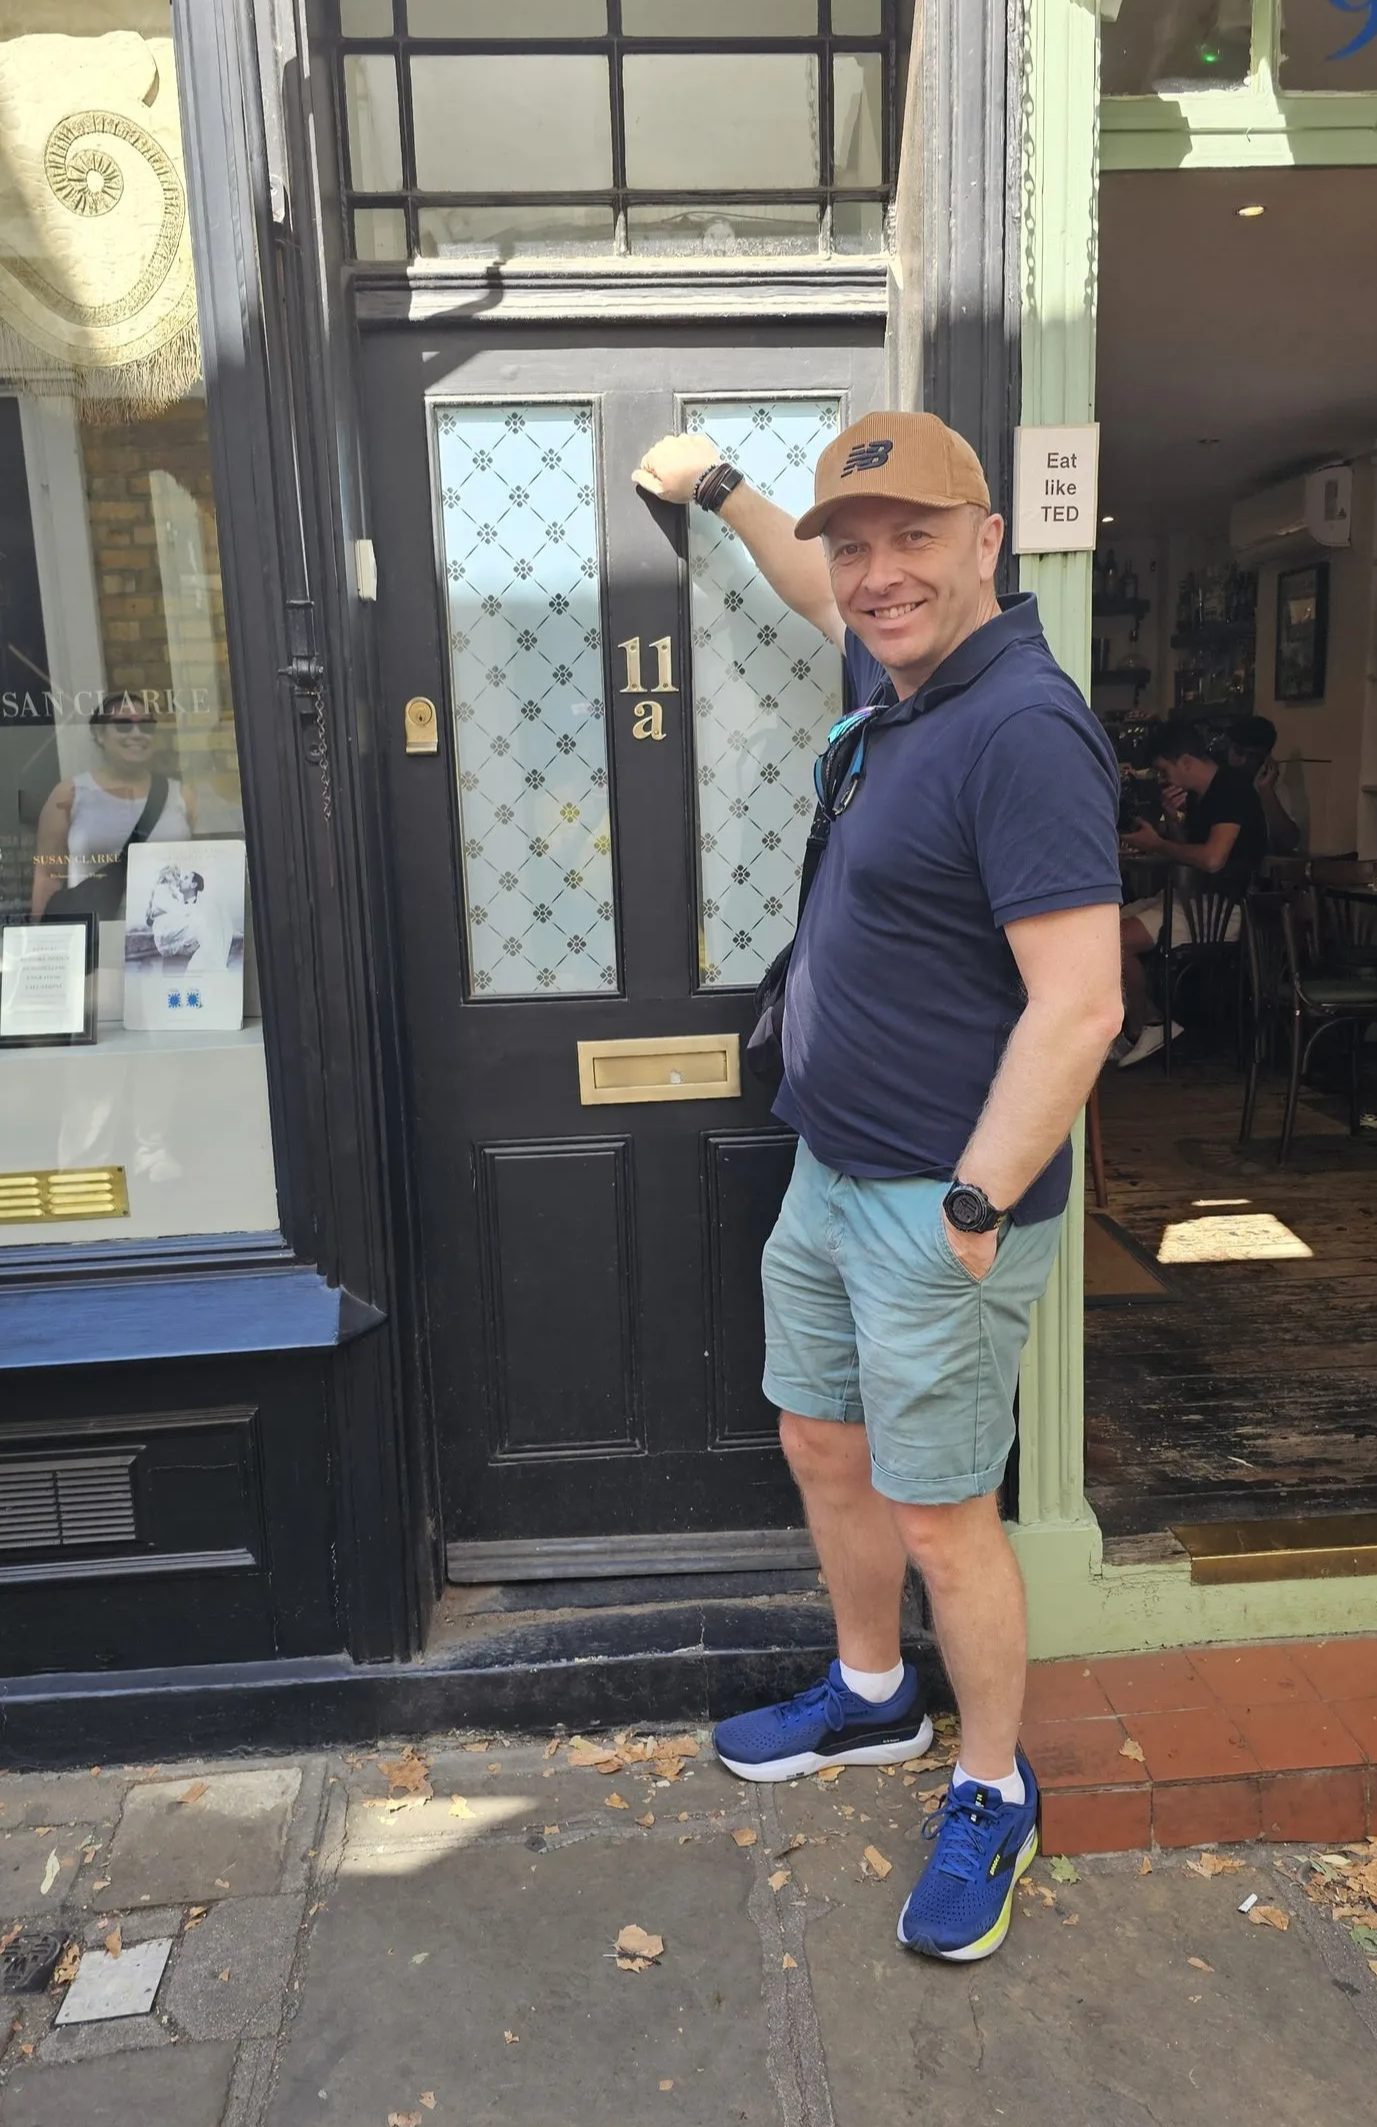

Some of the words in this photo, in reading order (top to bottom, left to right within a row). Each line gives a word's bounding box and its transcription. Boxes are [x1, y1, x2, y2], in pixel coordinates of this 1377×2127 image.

[1047, 452, 1077, 468] Eat
[1045, 479, 1076, 495] like
[1041, 506, 1079, 522] TED
[617, 636, 679, 692] 11
[2, 689, 64, 718] SAN
[74, 687, 210, 717] CLARKE
[632, 700, 667, 740] a
[32, 854, 71, 865] SUSAN
